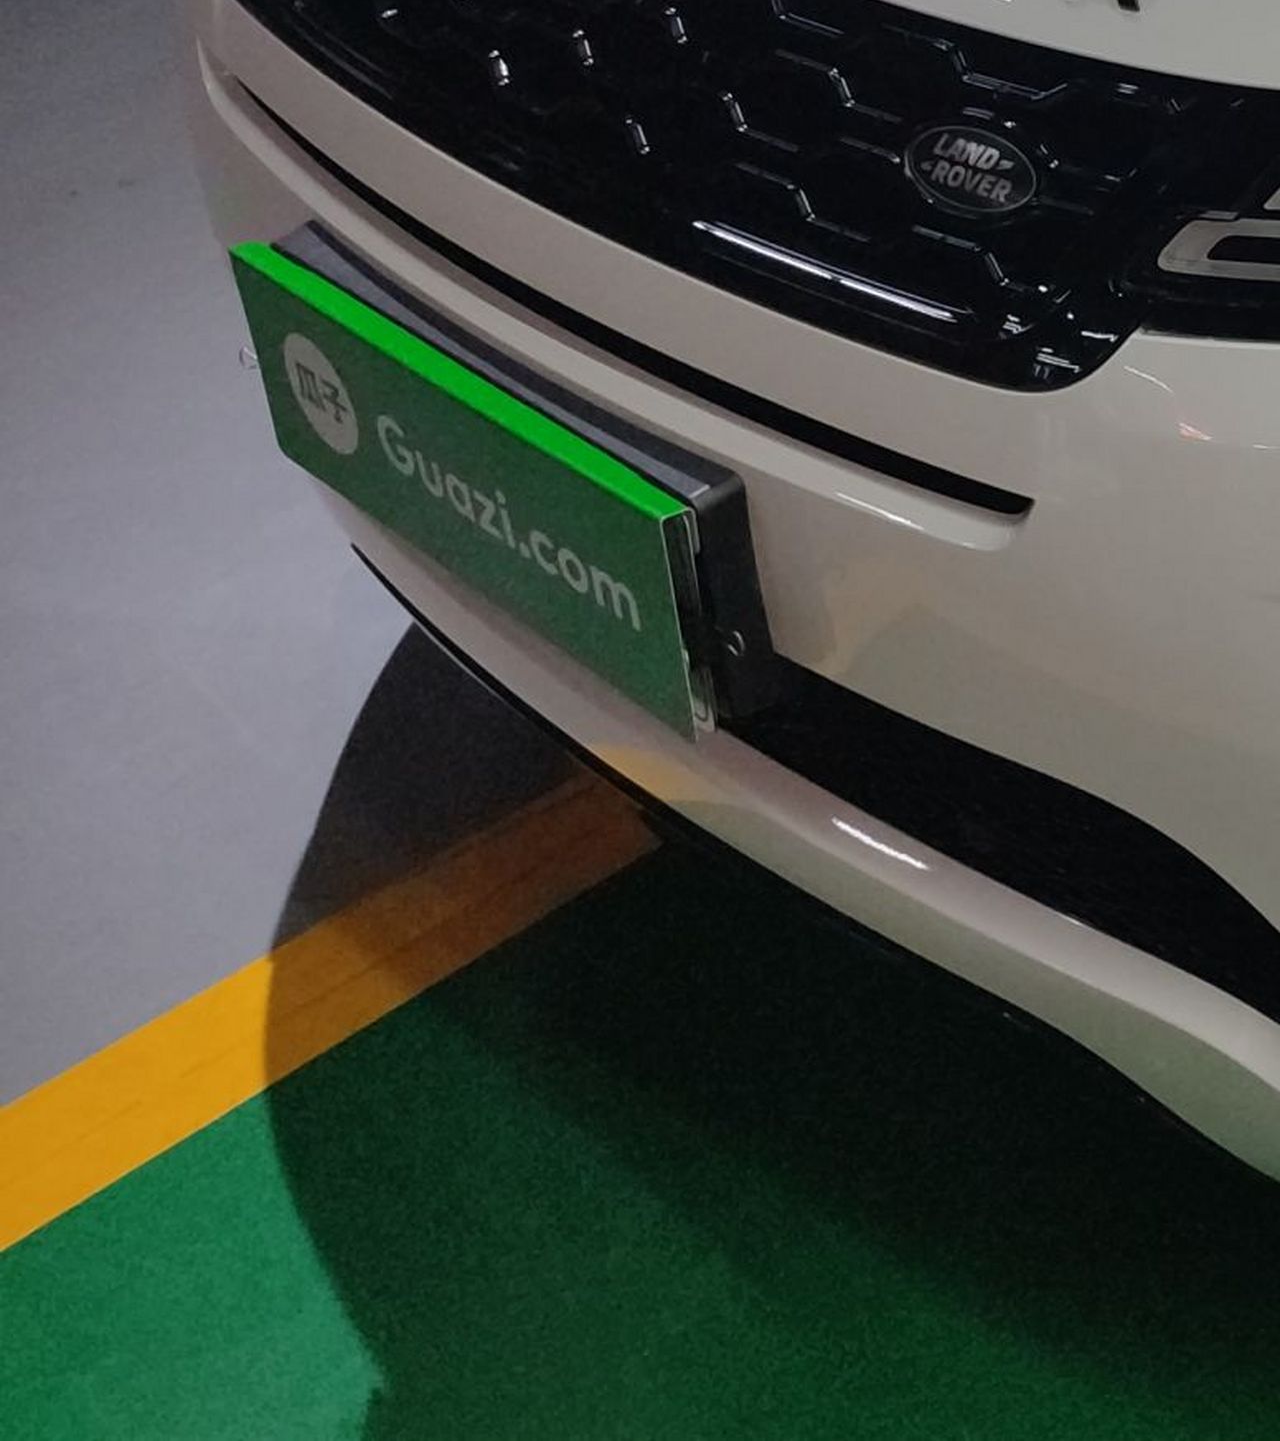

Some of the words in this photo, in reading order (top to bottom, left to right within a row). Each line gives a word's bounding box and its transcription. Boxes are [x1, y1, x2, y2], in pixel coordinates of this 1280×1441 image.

[933, 133, 1001, 171] LAND
[930, 160, 1013, 203] ROVER
[296, 361, 349, 425] 瓜子
[376, 414, 642, 633] Guazi.com
